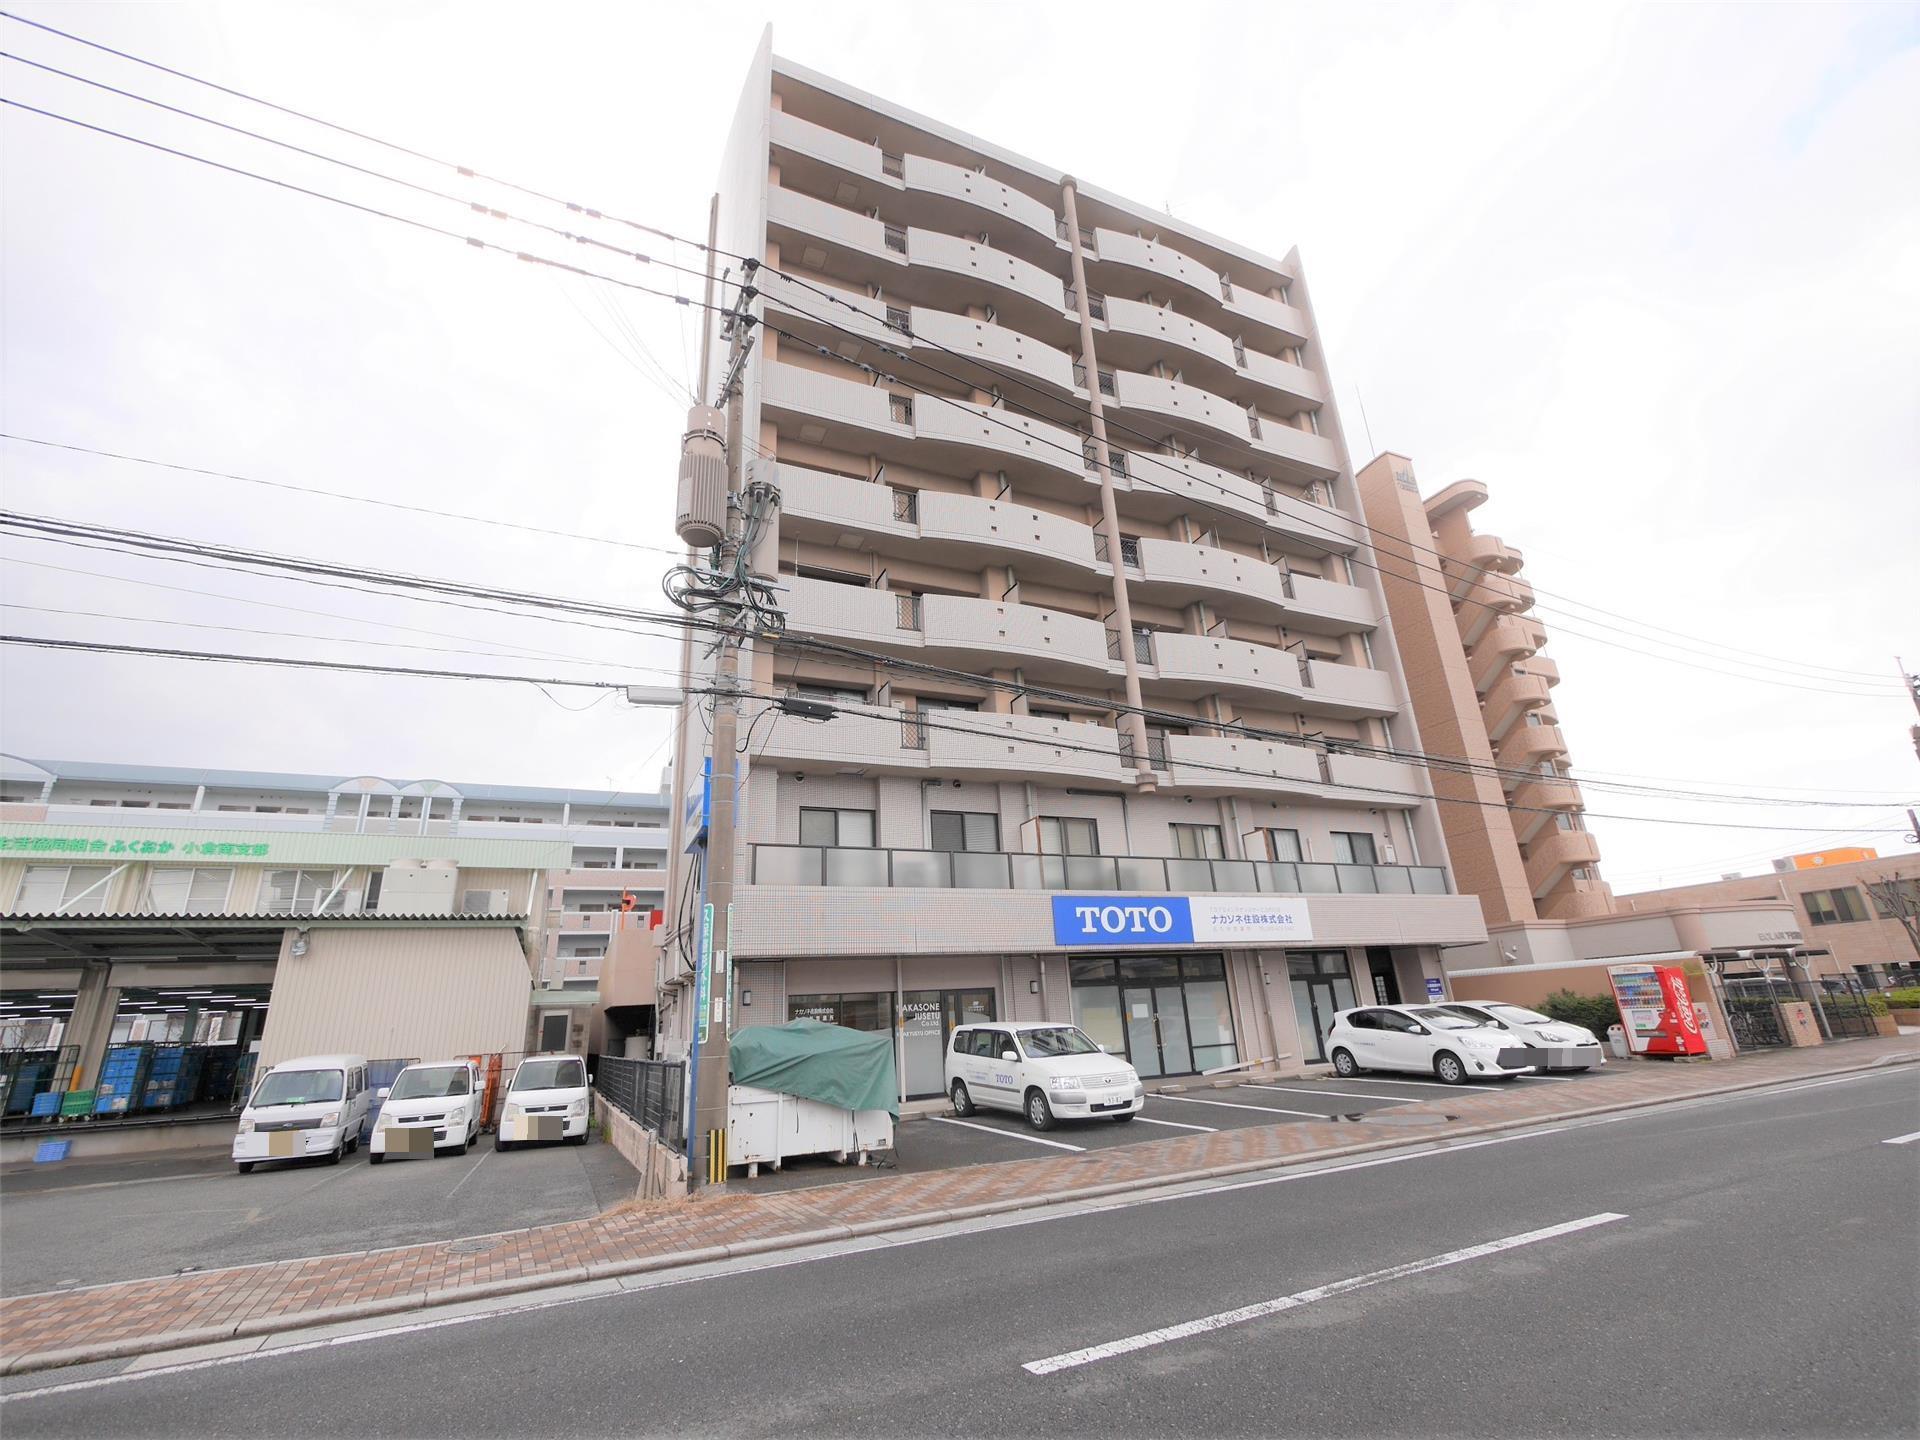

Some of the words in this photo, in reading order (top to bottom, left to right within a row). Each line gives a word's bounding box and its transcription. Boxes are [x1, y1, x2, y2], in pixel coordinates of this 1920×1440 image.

[1076, 906, 1172, 933] TOTO
[1211, 914, 1293, 924] ナカソネ住設株式会社
[1670, 974, 1697, 1034] Coca-Cola
[914, 1012, 940, 1020] JUSETU
[995, 1073, 1013, 1085] TOTO
